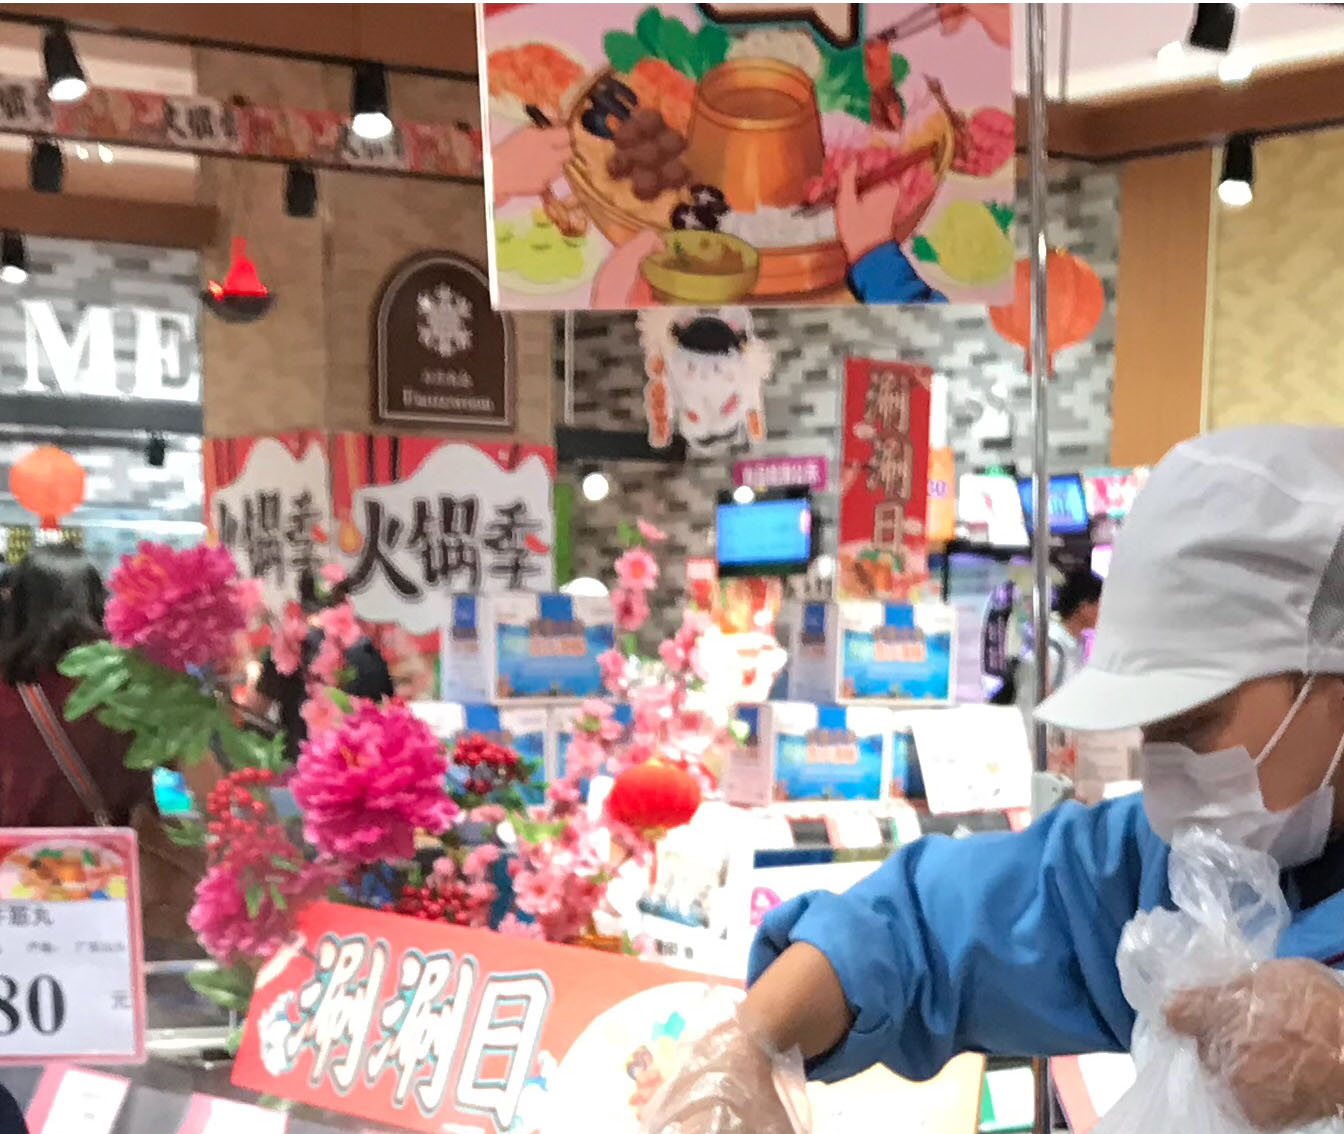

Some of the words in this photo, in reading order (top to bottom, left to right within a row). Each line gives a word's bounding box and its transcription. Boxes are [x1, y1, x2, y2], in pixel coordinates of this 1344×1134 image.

[18, 299, 200, 401] ME
[336, 494, 544, 598] 火锅季
[282, 932, 553, 1134] 涮涮日
